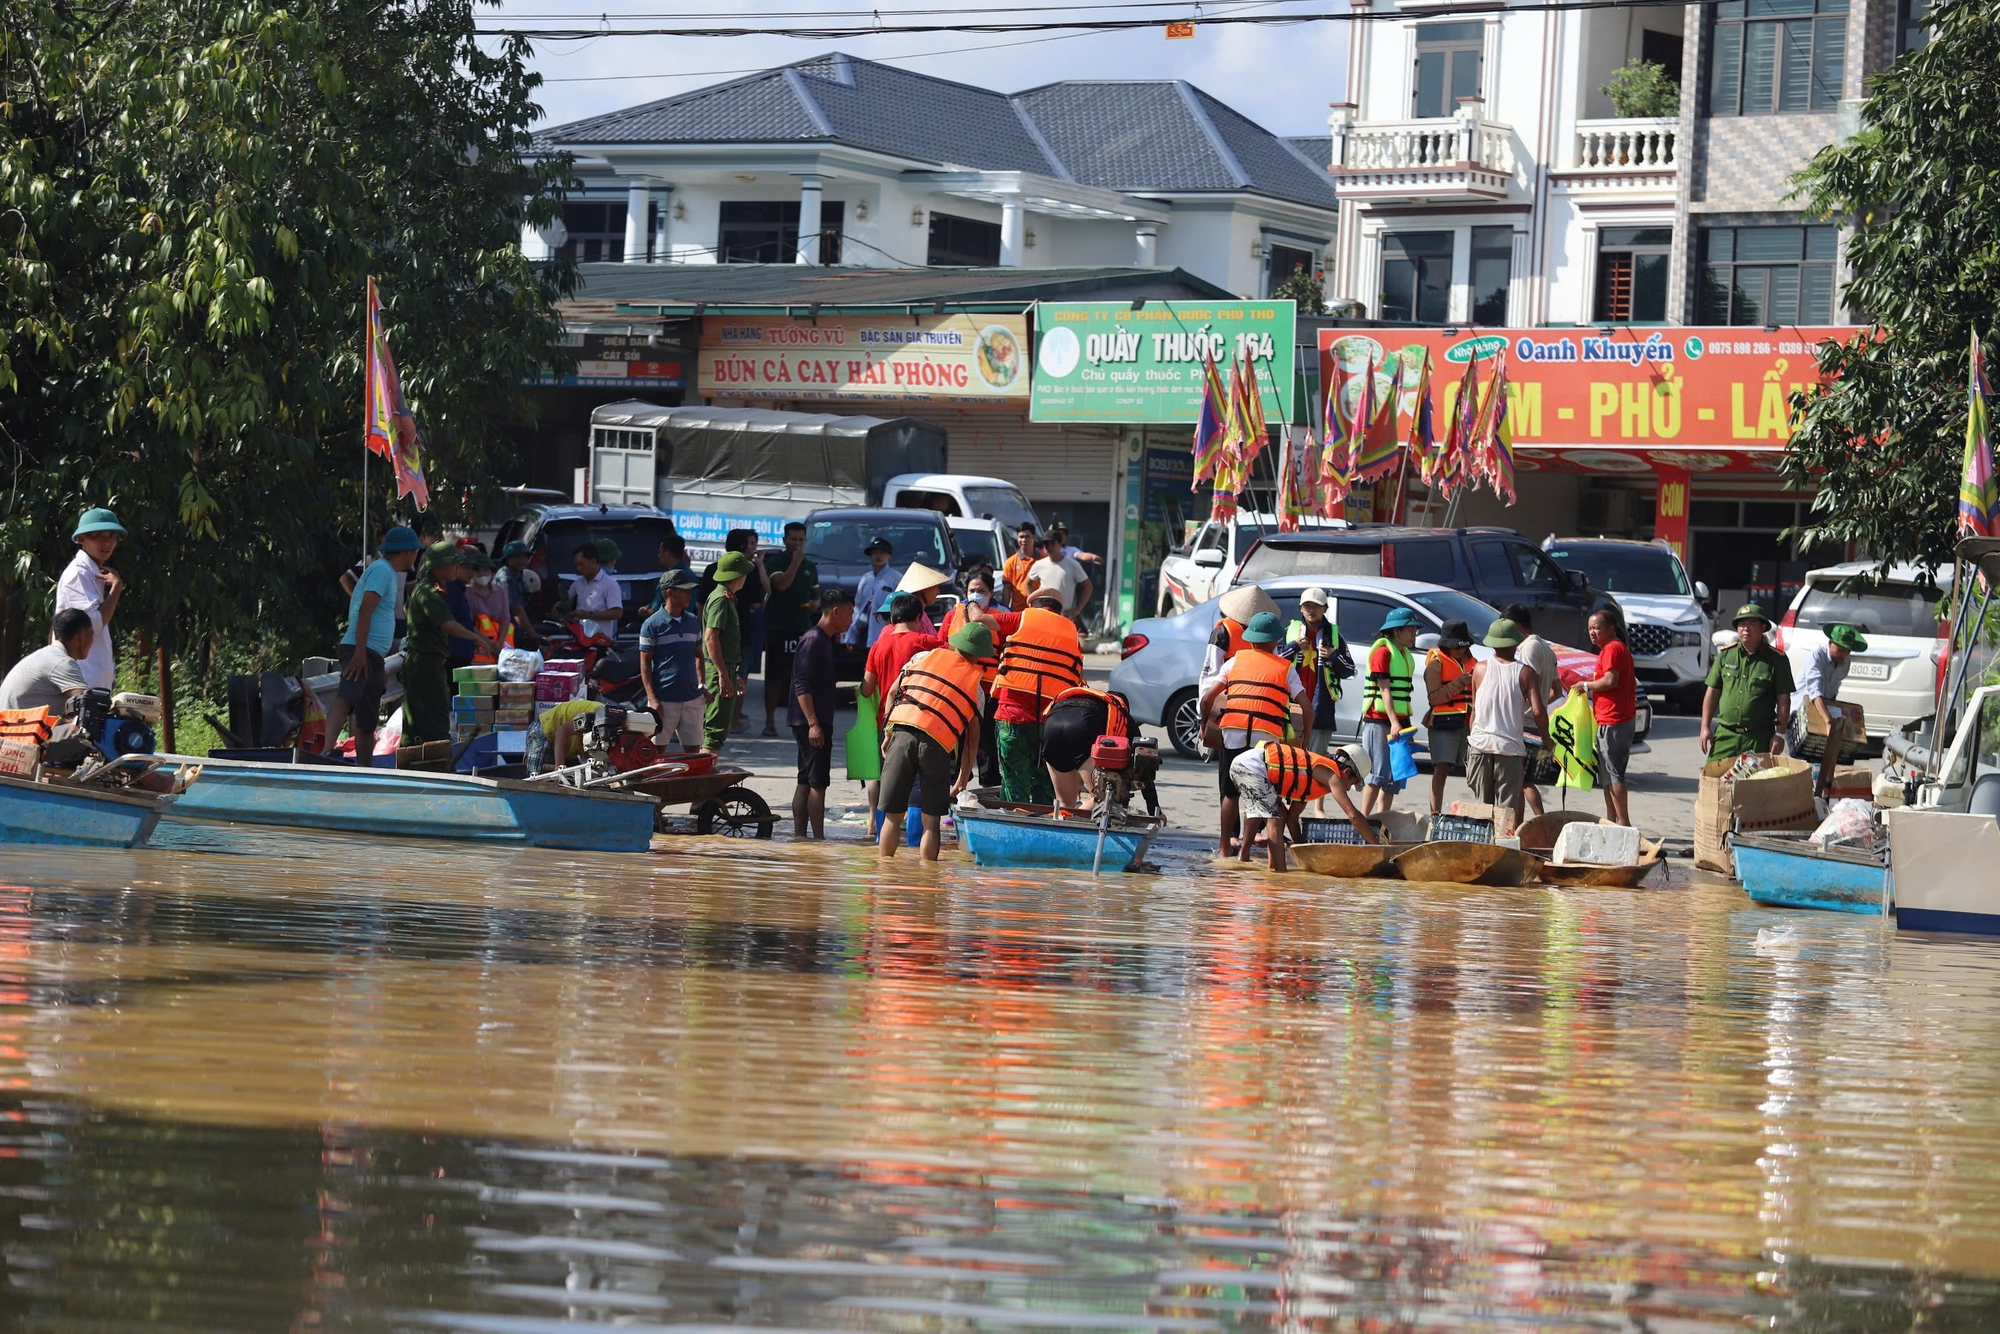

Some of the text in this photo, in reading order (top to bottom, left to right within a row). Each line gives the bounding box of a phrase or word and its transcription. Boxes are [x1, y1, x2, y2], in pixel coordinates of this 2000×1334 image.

[1094, 311, 1109, 322] TY
[823, 326, 845, 345] VŨ
[860, 330, 880, 346] ĐẶC
[883, 328, 903, 344] SẢN
[906, 331, 922, 344] GIA
[1086, 322, 1275, 367] QUẦY THUỐC 164
[1516, 332, 1674, 367] Oanh Khuyến
[1708, 341, 1732, 355] 0975
[1753, 341, 1771, 355] 266
[714, 350, 969, 389] BÚN CÁ CAY HẢI PHÒNG
[1081, 368, 1106, 381] Chủ
[1145, 366, 1182, 381] thuốc
[1444, 381, 1542, 438] CM
[1590, 362, 1684, 439] PHỞ
[1661, 480, 1685, 517] CƠM
[754, 518, 771, 535] GÓI
[126, 697, 154, 706] HYUNDAI
